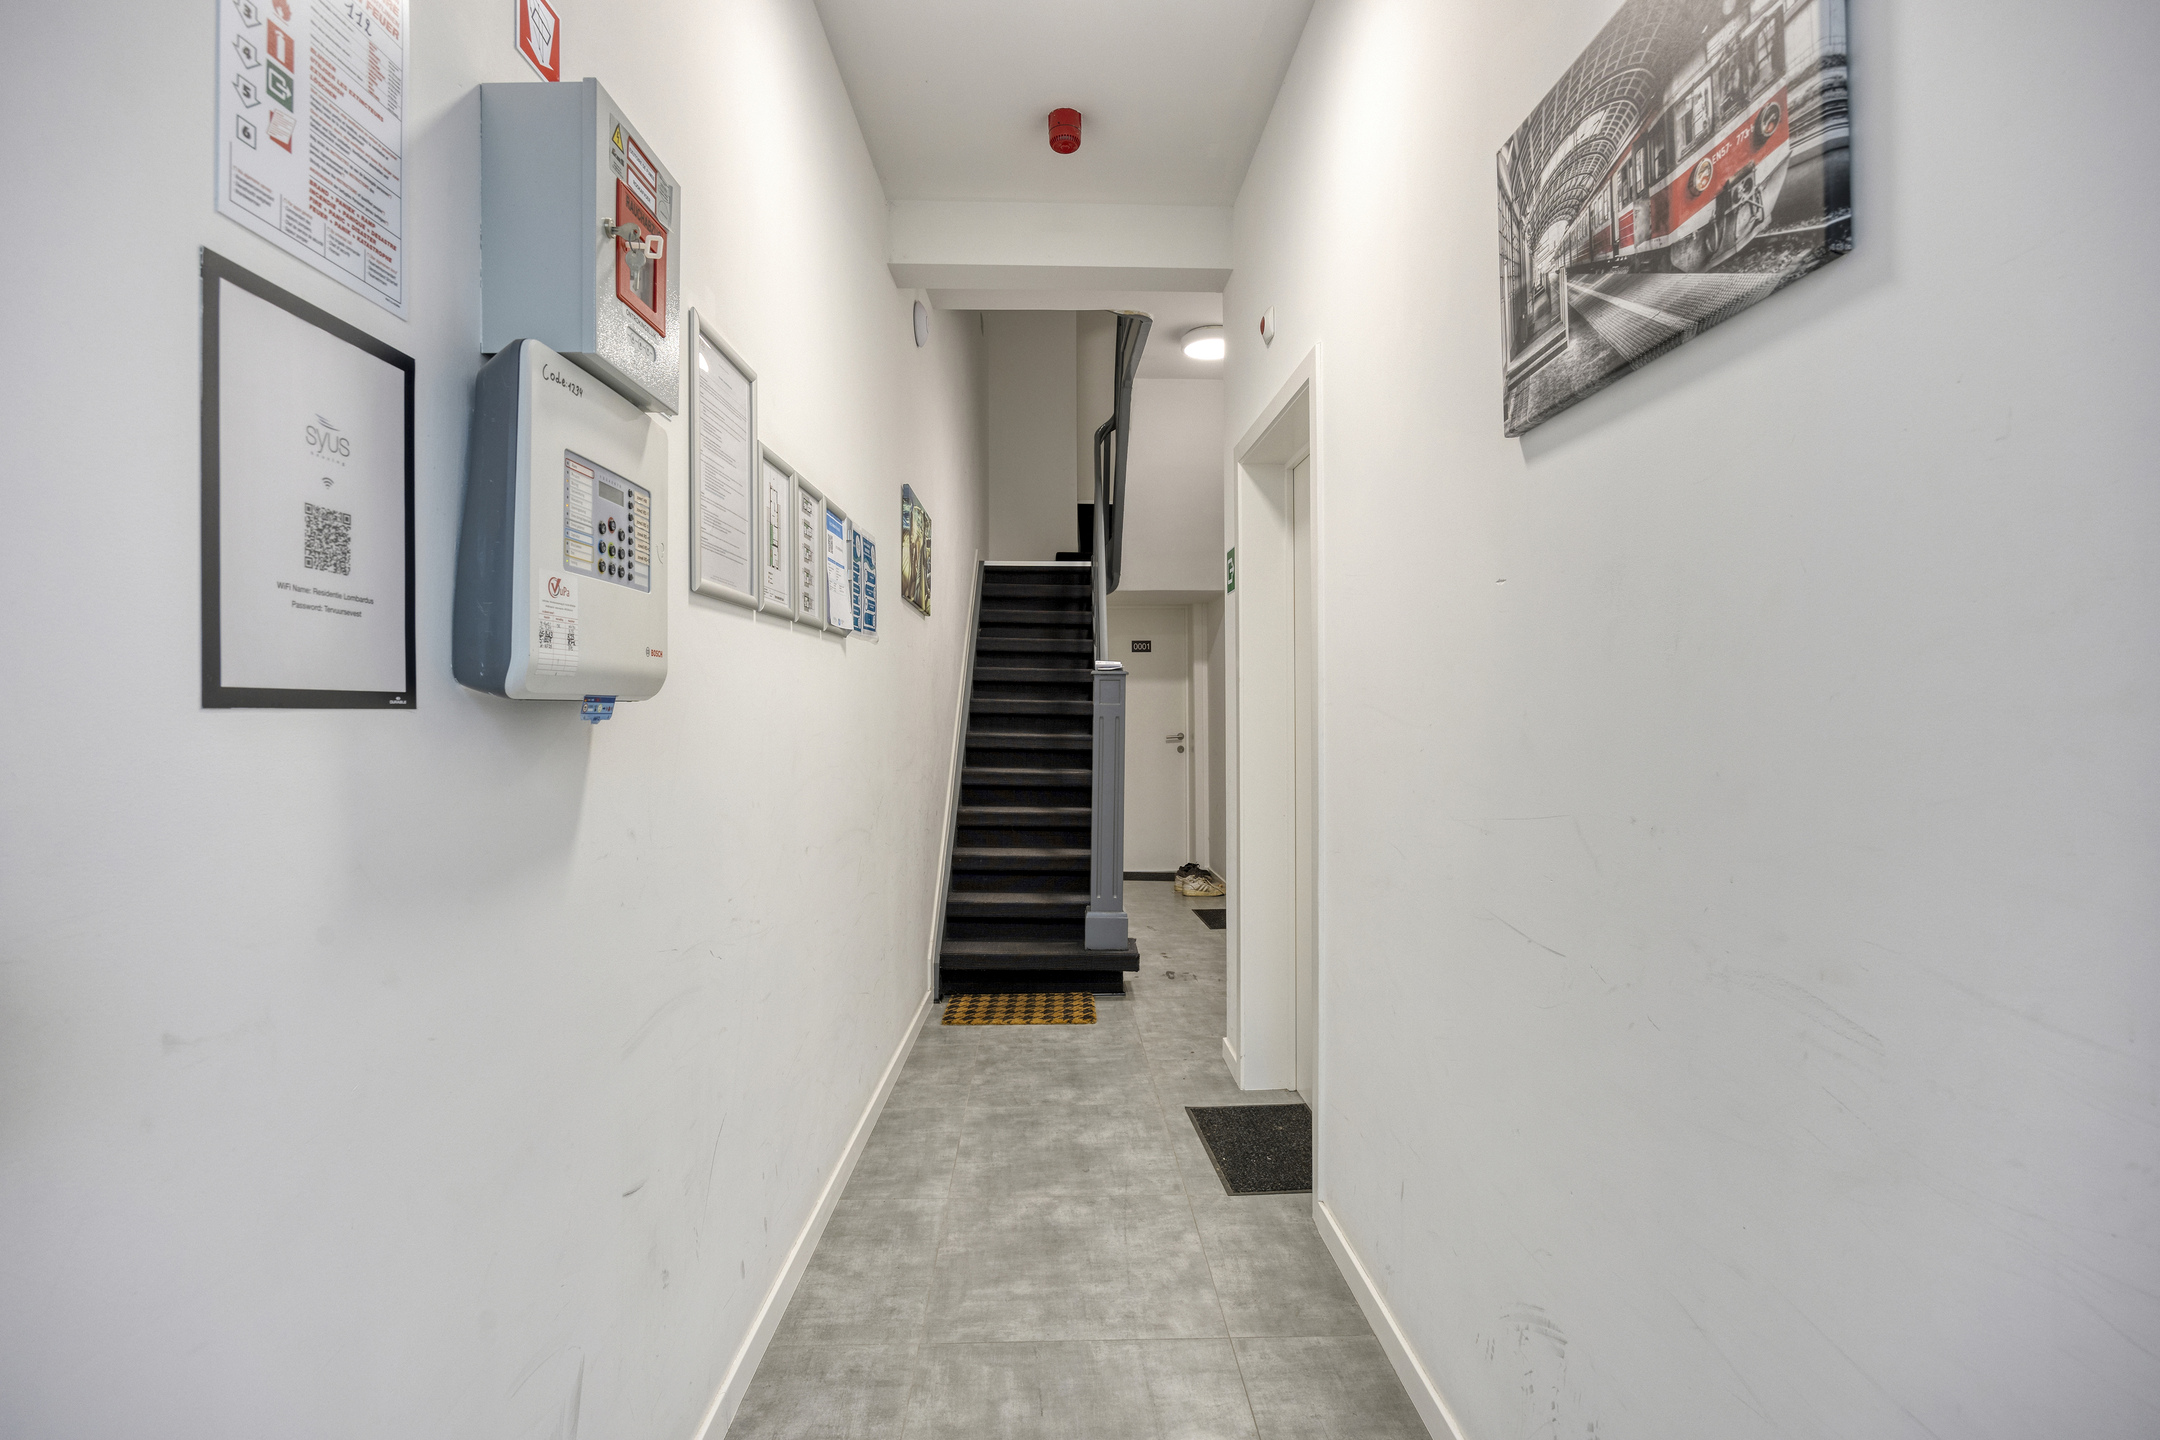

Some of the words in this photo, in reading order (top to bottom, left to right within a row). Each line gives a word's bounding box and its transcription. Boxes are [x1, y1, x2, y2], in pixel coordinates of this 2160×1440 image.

[244, 4, 252, 18] 3
[344, 3, 372, 36] 112
[366, 1, 400, 40] FEUER
[243, 46, 252, 60] 4
[243, 85, 251, 98] 5
[348, 87, 383, 123] EXTINCTEURS
[242, 128, 251, 140] 6
[309, 194, 321, 209] FIRE
[276, 581, 291, 591] WiFi
[292, 584, 312, 594] Name:
[291, 600, 323, 612] Password:
[651, 649, 663, 658] BOSCH
